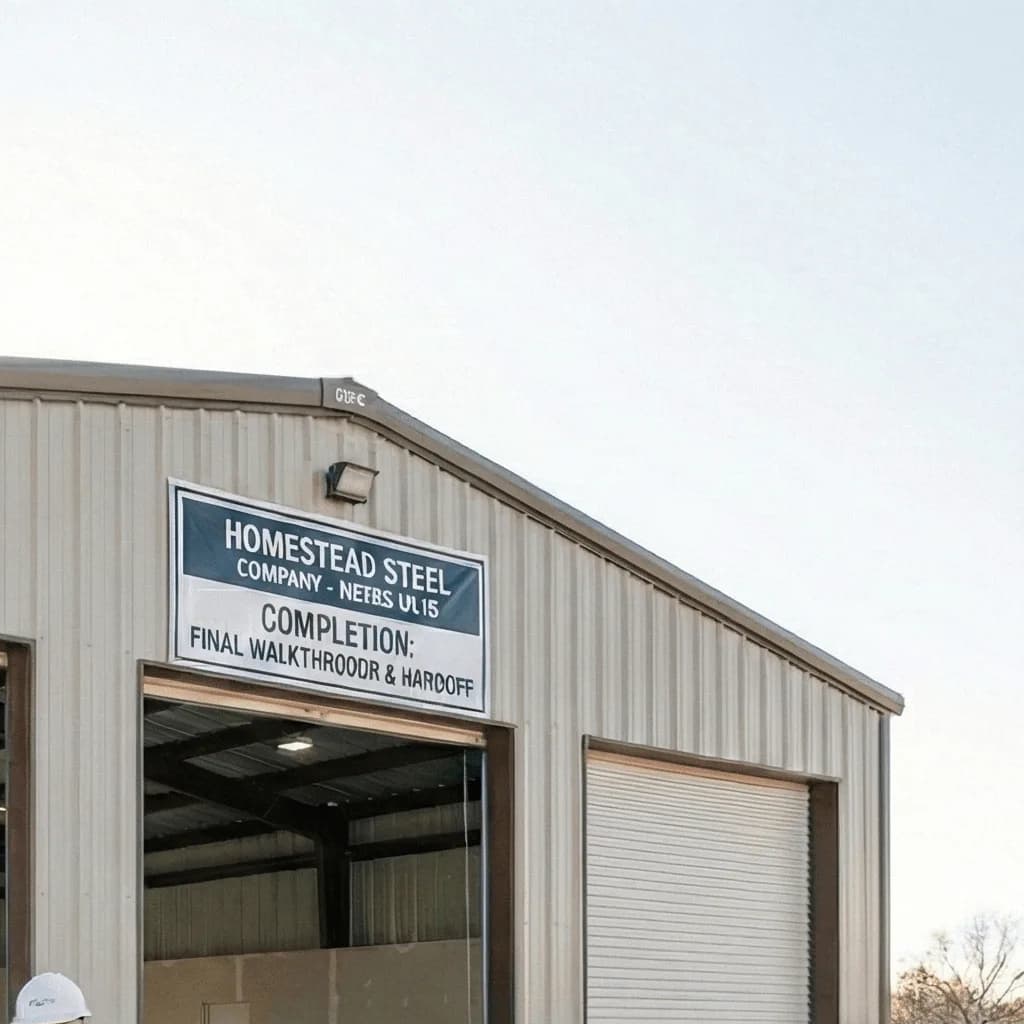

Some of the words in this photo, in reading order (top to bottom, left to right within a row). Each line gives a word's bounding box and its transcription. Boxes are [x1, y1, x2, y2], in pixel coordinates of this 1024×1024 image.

[225, 518, 376, 578] HOMESTEAD
[383, 557, 452, 596] STEEL
[237, 558, 322, 592] COMPANY
[190, 625, 244, 657] FINAL
[384, 663, 396, 686] &
